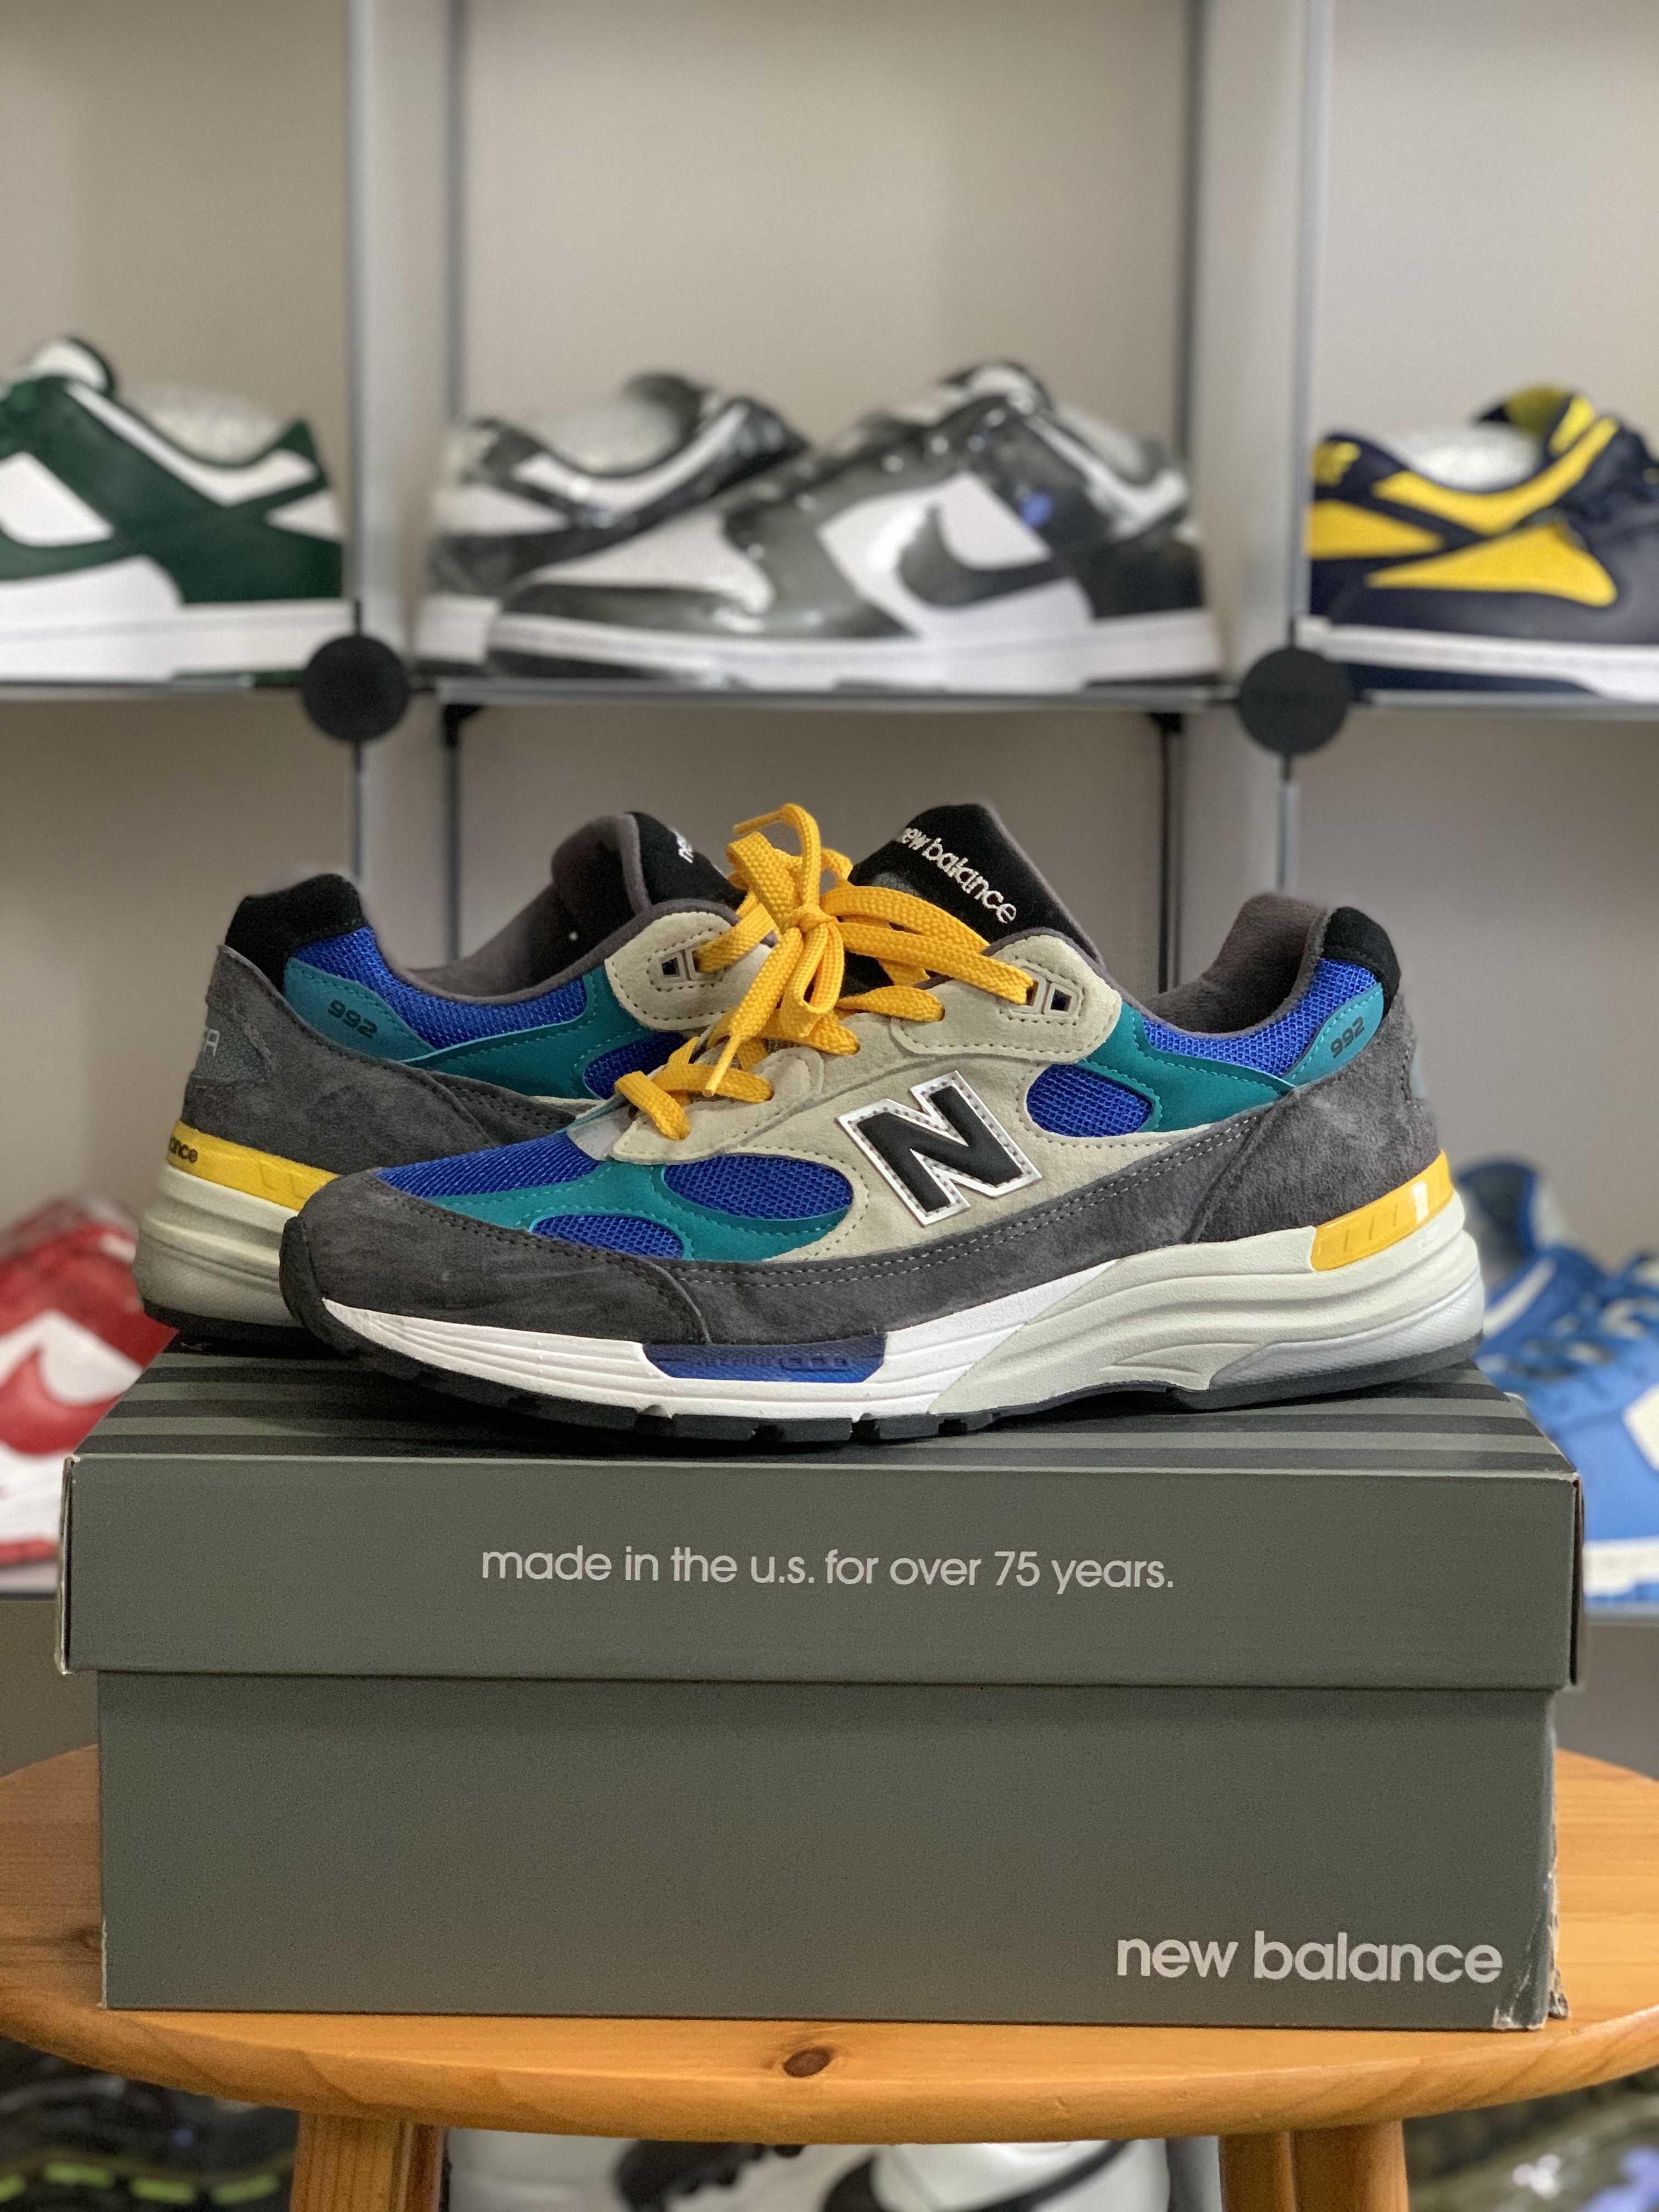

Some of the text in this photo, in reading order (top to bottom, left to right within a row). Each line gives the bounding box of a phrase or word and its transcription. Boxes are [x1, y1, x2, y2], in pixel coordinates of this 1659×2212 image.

[921, 837, 1017, 924] balance
[328, 999, 378, 1040] 992
[1330, 1016, 1365, 1059] 992
[836, 1070, 1042, 1227] N
[482, 1545, 1174, 1595] made in the u.s. for over 75 years.
[1117, 1930, 1503, 1983] new balance
